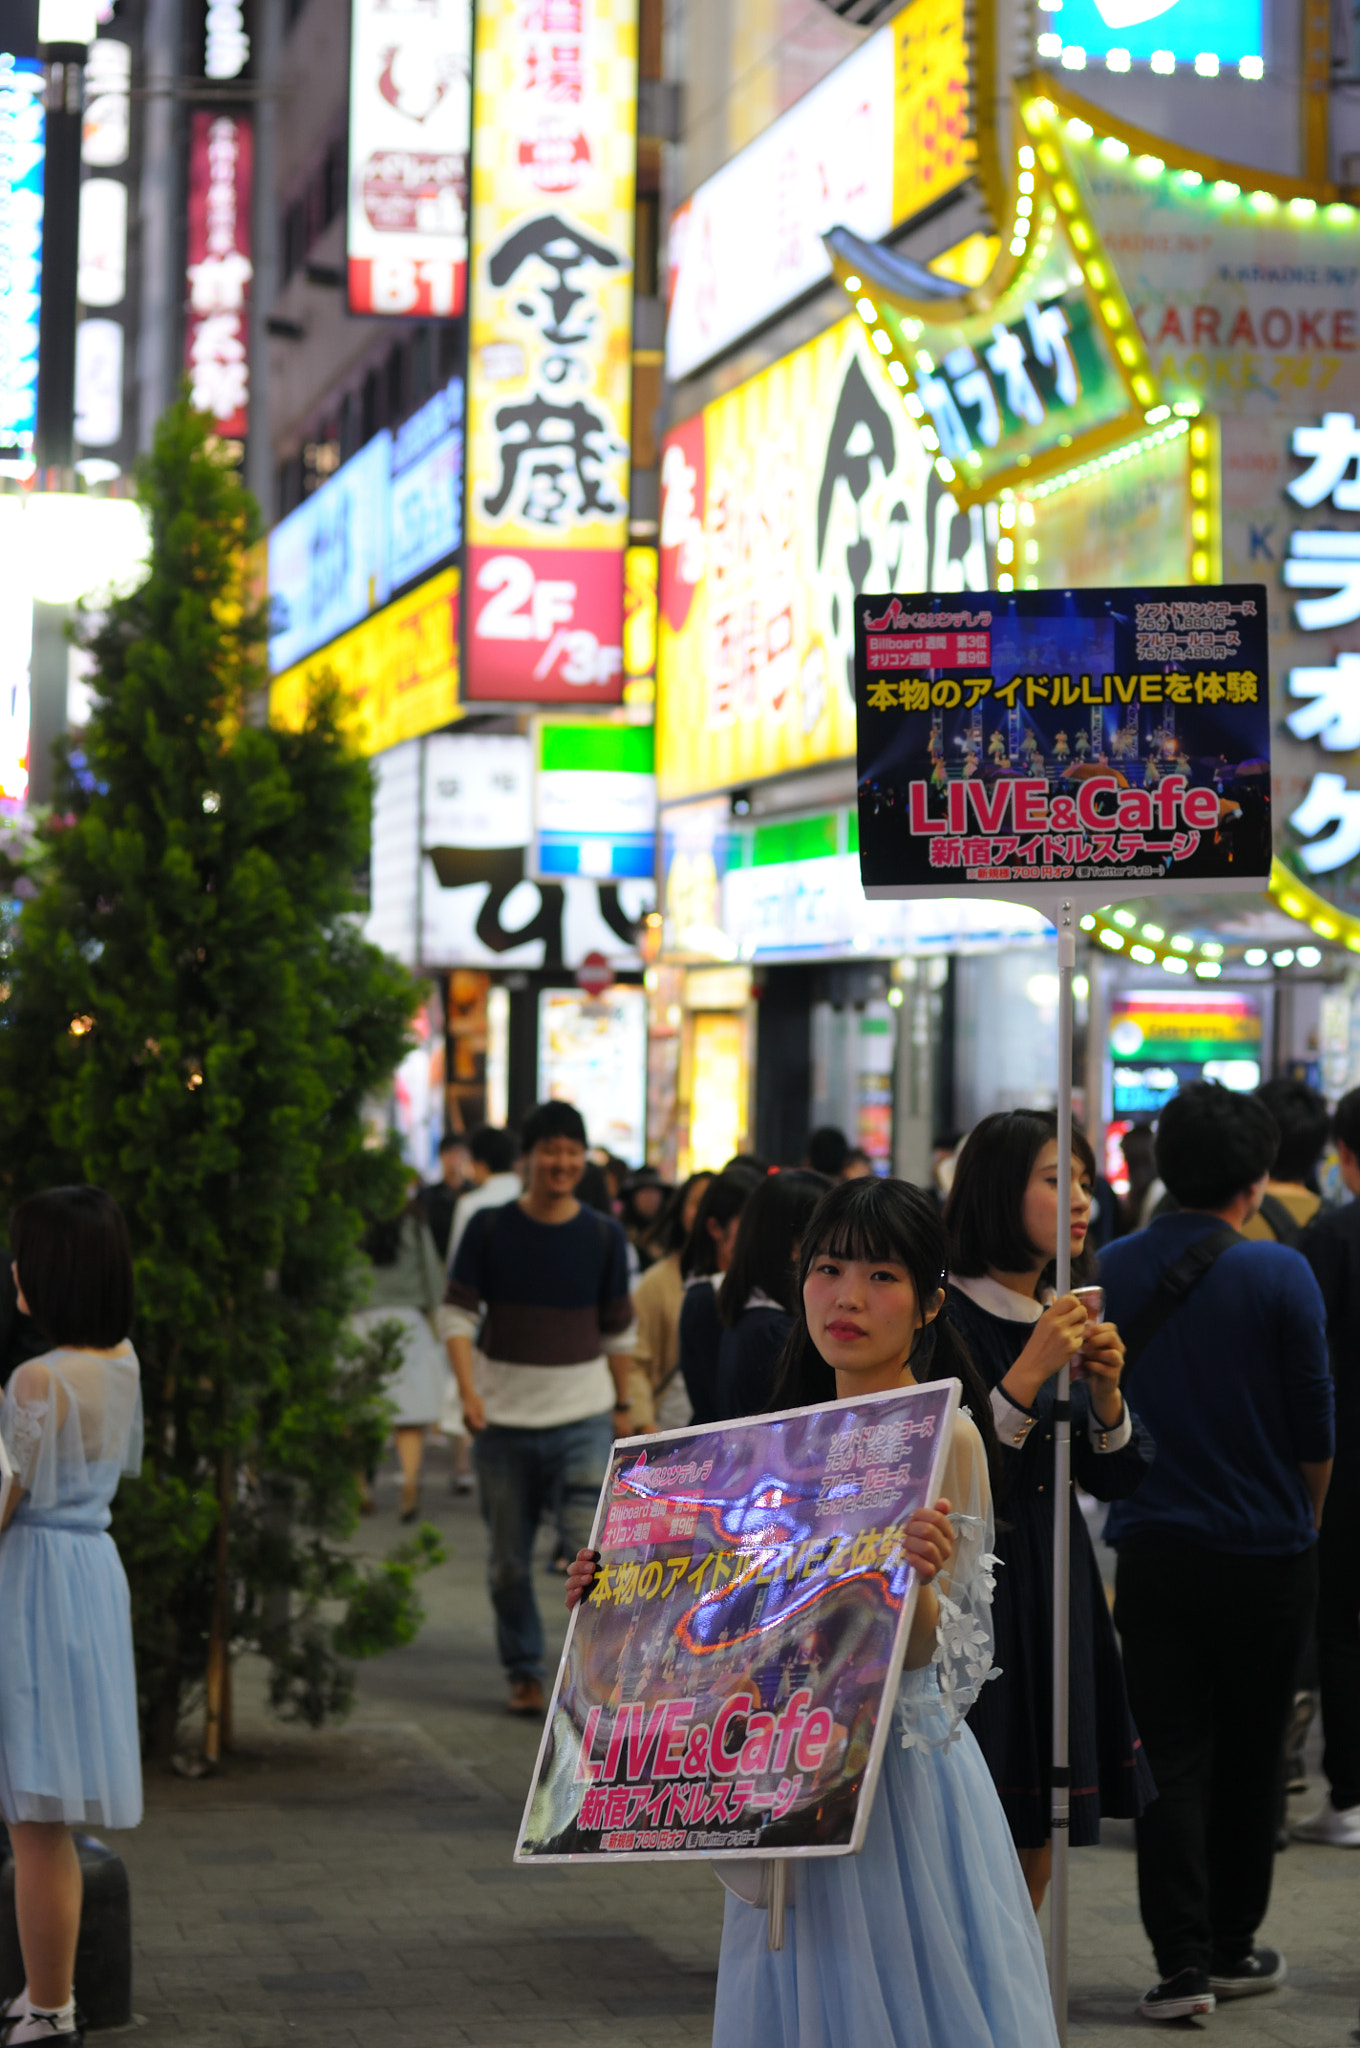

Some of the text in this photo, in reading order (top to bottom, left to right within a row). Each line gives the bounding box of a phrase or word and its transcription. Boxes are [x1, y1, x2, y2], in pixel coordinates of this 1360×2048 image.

[371, 258, 454, 316] B1
[484, 213, 627, 525] 金の蔵
[915, 300, 1078, 461] カラオケ
[475, 555, 577, 641] 2F
[1135, 601, 1258, 618] ソフトドリンクコース
[956, 635, 987, 649] 第3位
[956, 650, 987, 665] 第9位
[1136, 631, 1241, 648] アルコールコース
[1284, 412, 1360, 875] カラオケ
[866, 671, 1259, 712] 本物のアイドルLIVEを体験
[909, 775, 1219, 835] LIVE&Cafe
[929, 831, 1200, 867] 新宿アイドルステージ
[829, 1415, 936, 1453] ソフトドリンクコース
[574, 1687, 833, 1783] LIVE&Cafe
[577, 1775, 803, 1831] 新宿アイドルステージ
